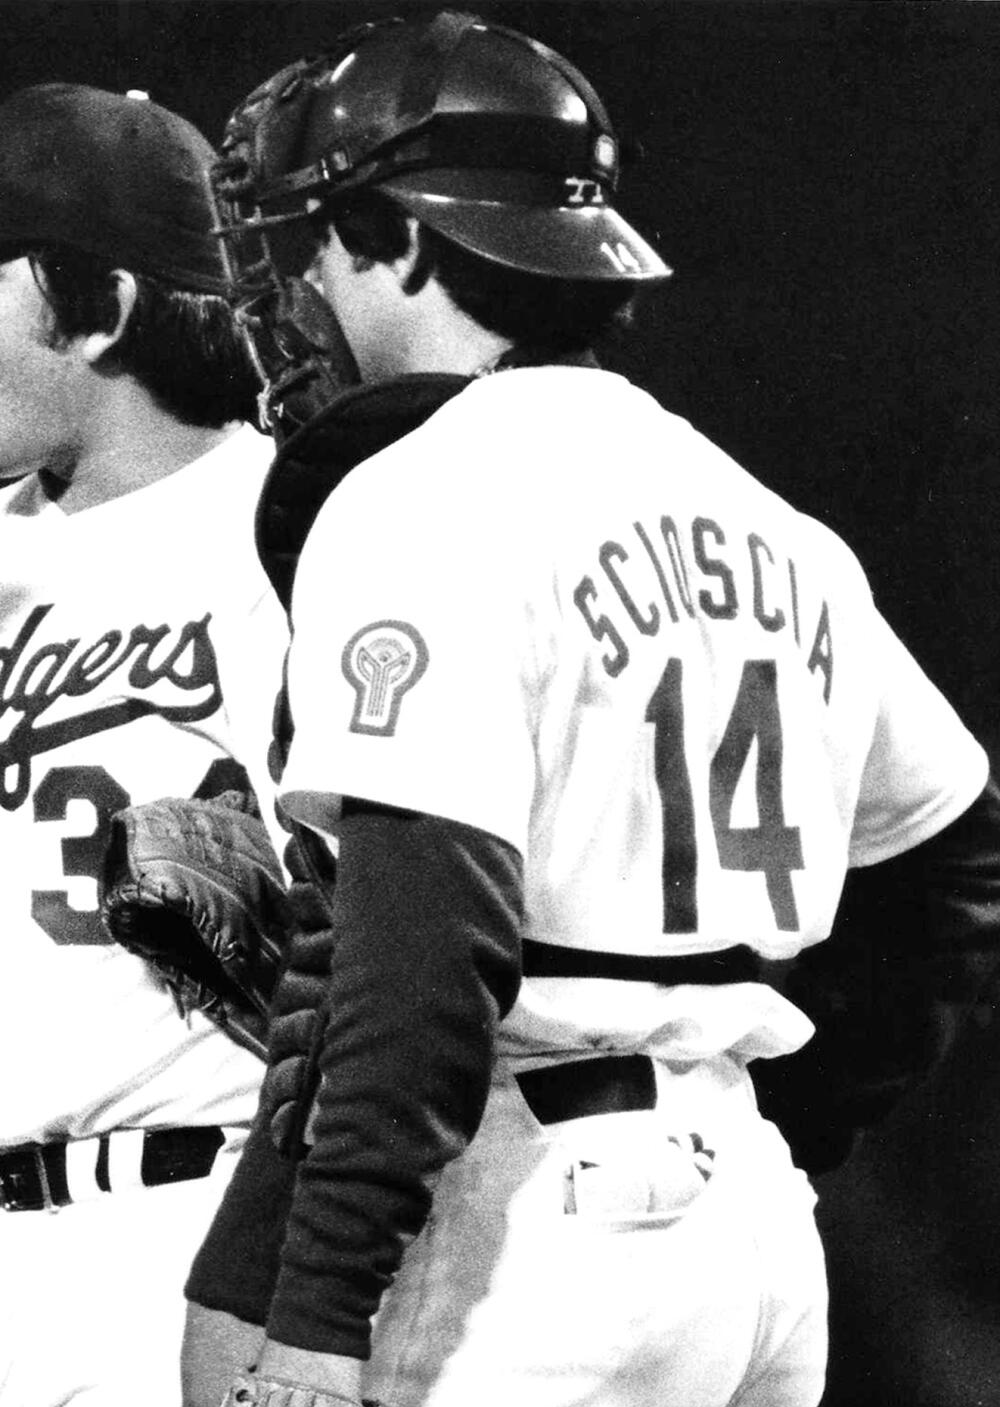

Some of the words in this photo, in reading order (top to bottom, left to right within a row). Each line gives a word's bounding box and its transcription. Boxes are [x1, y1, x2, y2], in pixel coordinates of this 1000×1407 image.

[573, 514, 834, 707] SCIOSCIA
[31, 758, 265, 946] 3
[644, 657, 806, 935] 14
